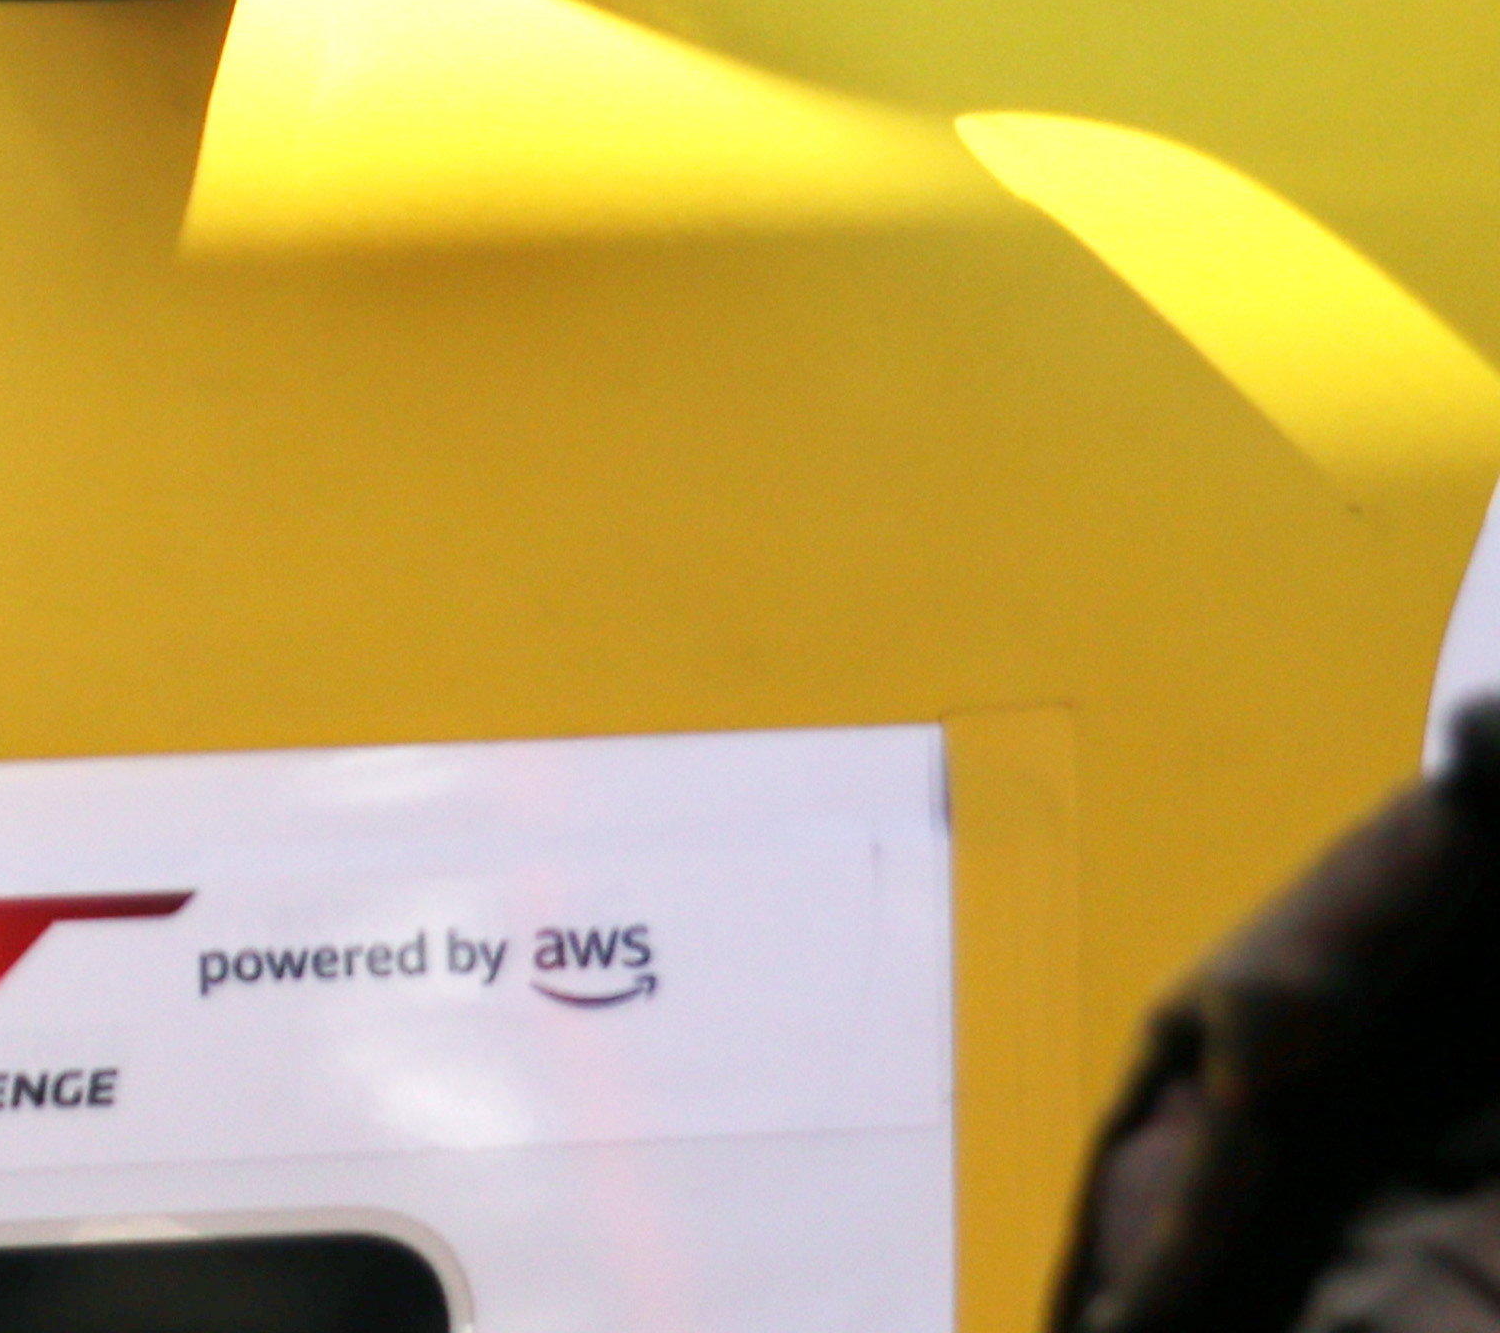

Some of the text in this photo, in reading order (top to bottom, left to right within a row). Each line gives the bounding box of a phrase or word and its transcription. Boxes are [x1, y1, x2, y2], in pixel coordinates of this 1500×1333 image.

[199, 924, 653, 997] powered by aws
